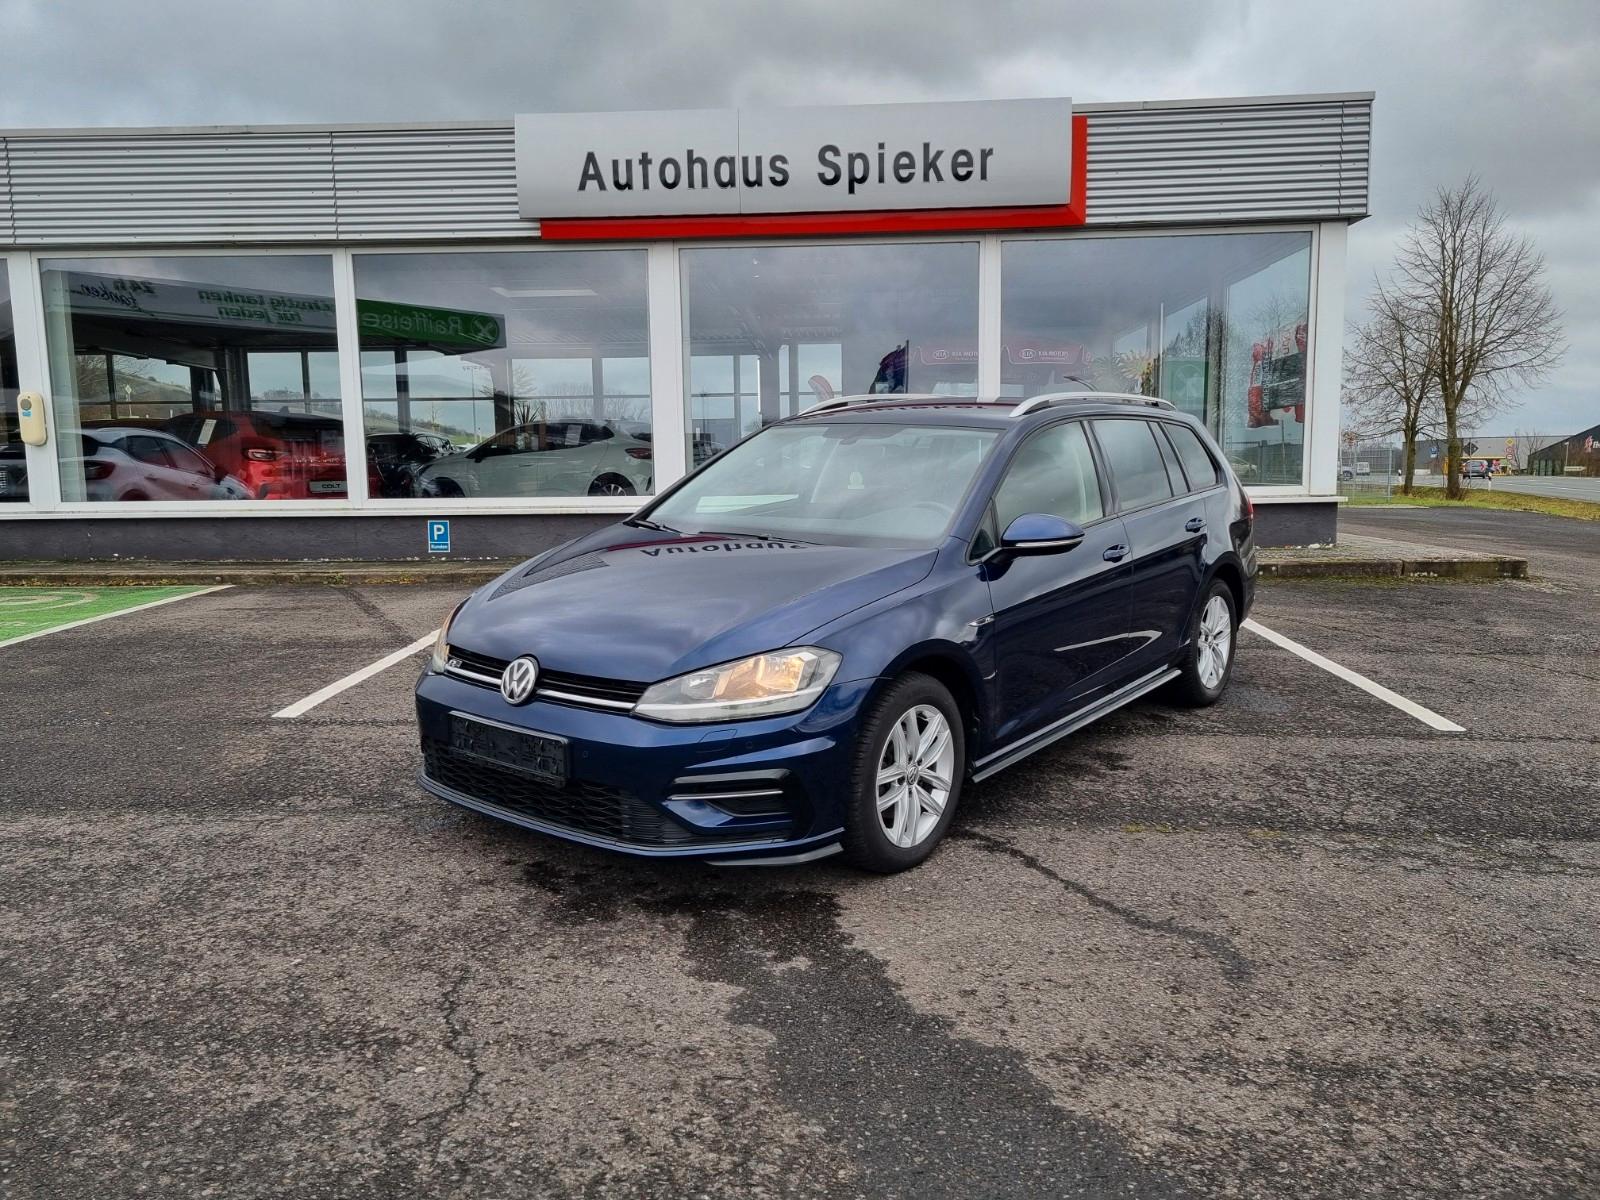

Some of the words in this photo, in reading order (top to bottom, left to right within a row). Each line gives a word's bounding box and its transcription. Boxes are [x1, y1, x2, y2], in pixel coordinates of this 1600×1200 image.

[577, 149, 790, 192] Autohaus
[817, 142, 994, 195] Spieker
[433, 524, 445, 541] P
